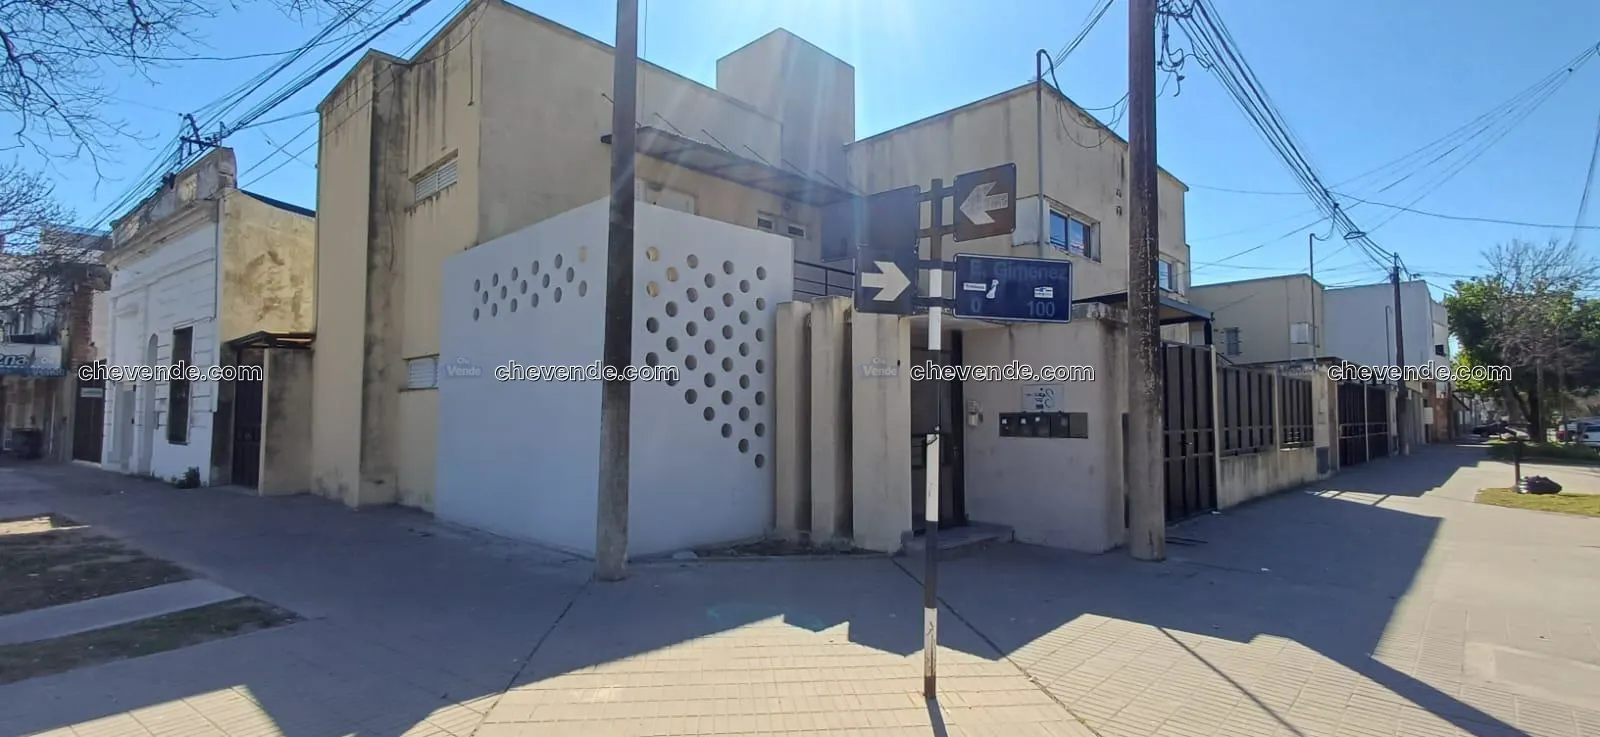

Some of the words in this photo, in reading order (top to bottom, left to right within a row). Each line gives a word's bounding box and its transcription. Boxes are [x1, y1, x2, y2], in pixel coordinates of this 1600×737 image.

[970, 260, 987, 279] E.
[970, 298, 982, 314] 0
[1026, 300, 1055, 318] 100
